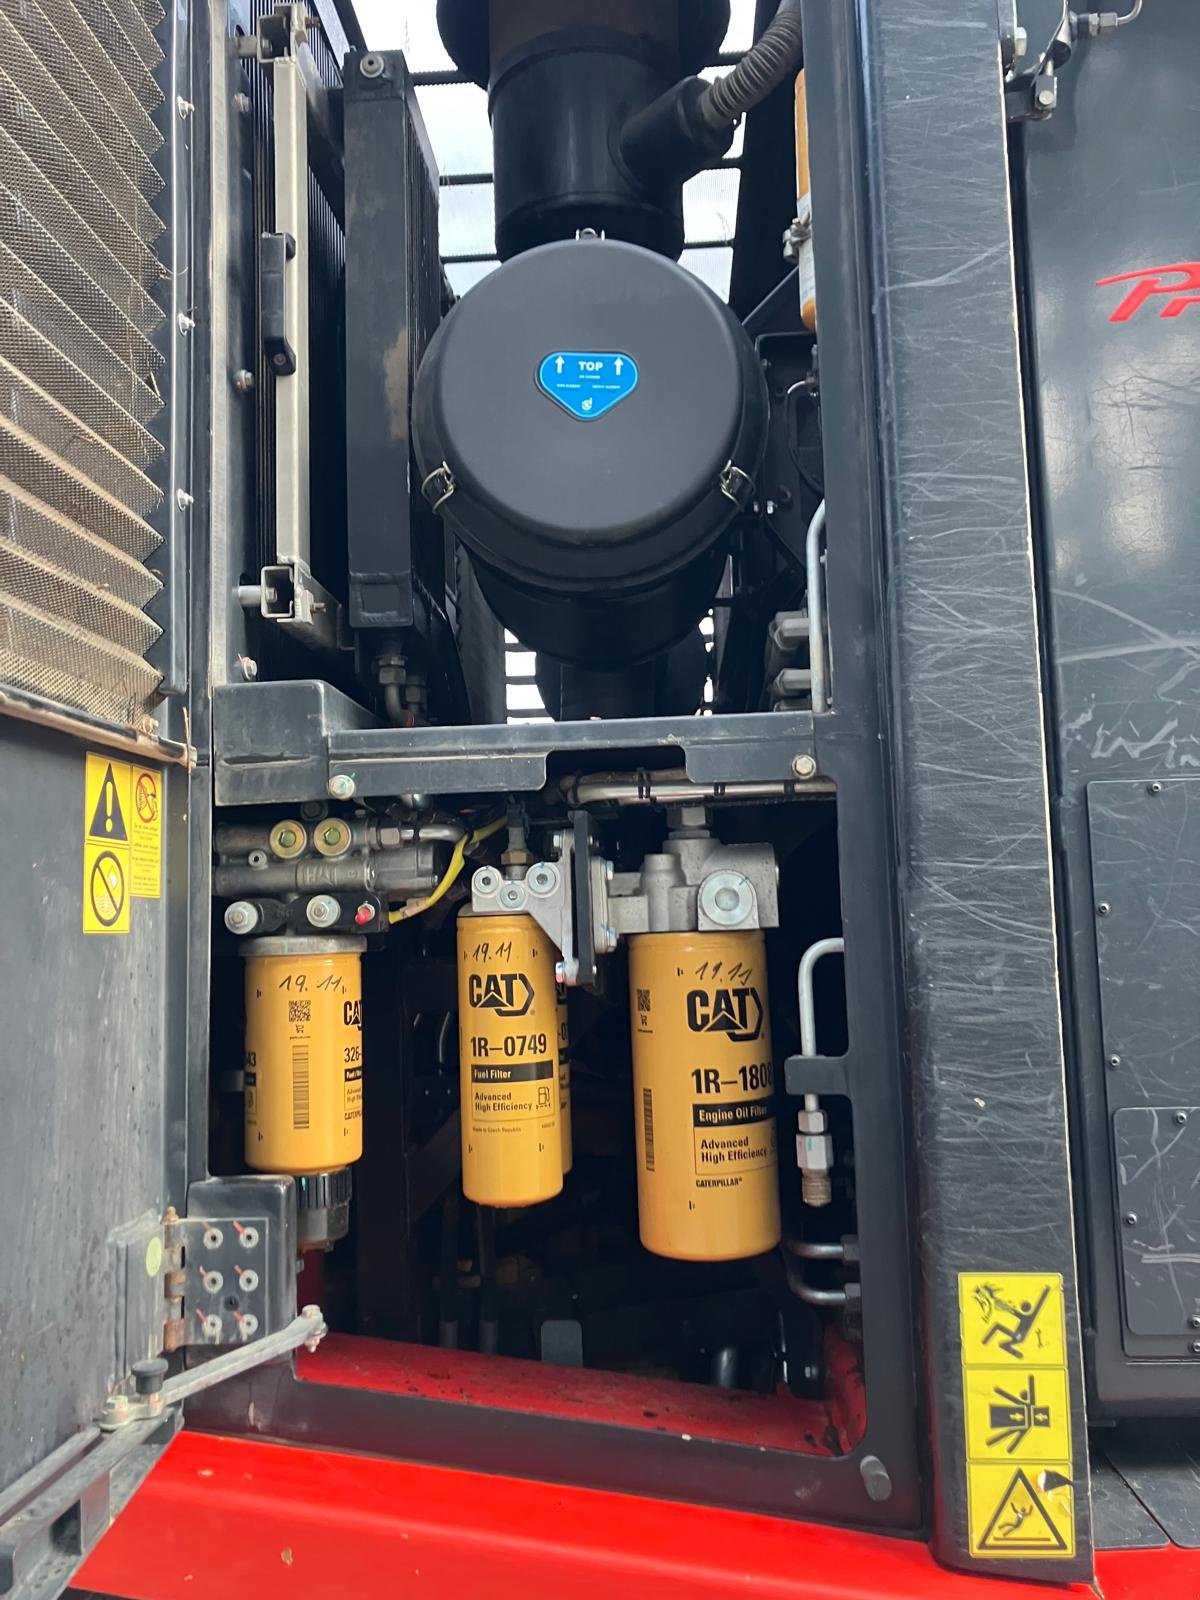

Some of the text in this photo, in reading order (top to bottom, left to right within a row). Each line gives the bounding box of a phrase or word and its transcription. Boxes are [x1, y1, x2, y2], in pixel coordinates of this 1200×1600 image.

[578, 361, 604, 371] TOP
[469, 973, 518, 1008] CAT
[344, 1000, 361, 1026] CA
[687, 988, 750, 1032] CAT
[470, 1033, 547, 1057] 1R-0749
[474, 1069, 511, 1079] Fuel Filter
[475, 1092, 512, 1101] Advanced
[475, 1102, 533, 1113] High Efficiency
[699, 1109, 734, 1124] Engine
[736, 1106, 749, 1119] Oil
[701, 1136, 749, 1150] Advanced
[701, 1148, 768, 1164] High Efficiency
